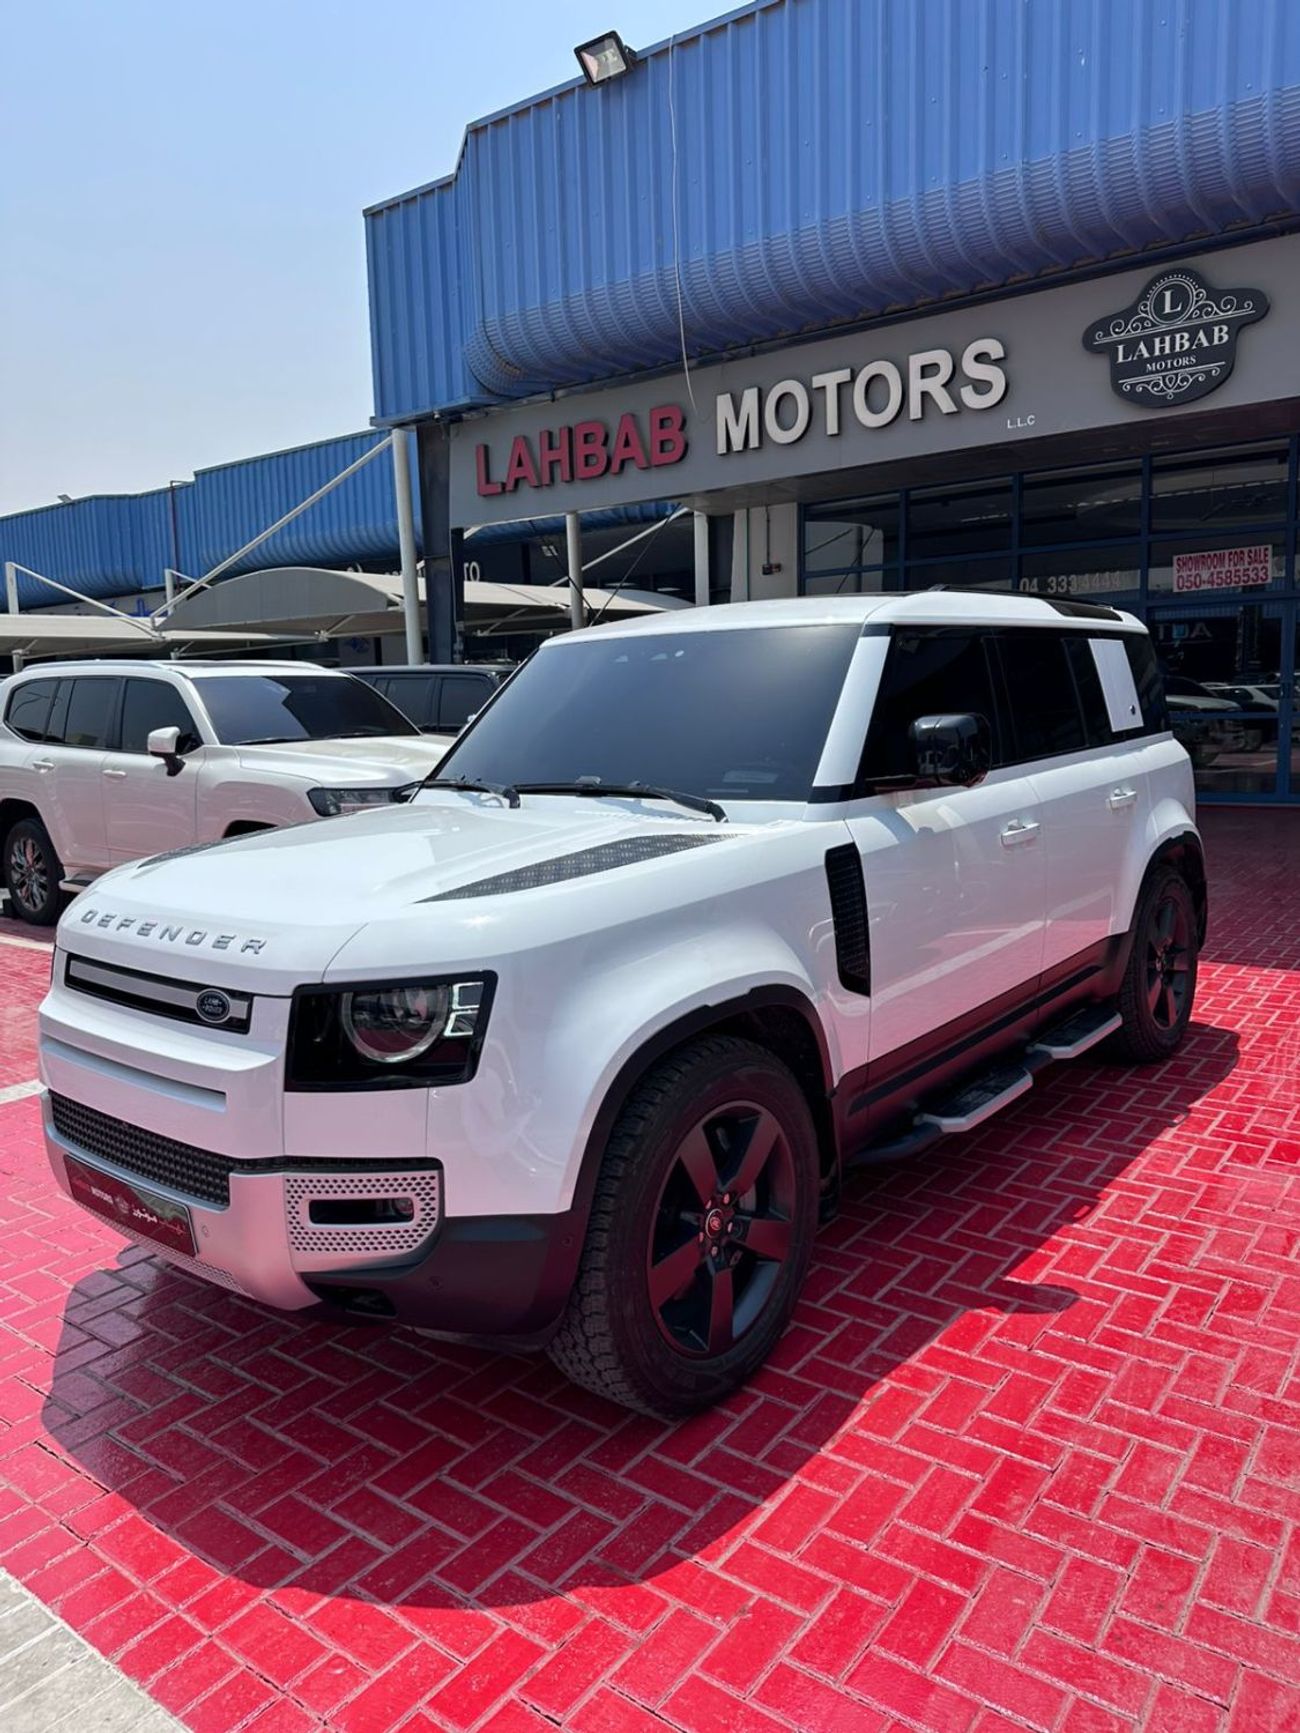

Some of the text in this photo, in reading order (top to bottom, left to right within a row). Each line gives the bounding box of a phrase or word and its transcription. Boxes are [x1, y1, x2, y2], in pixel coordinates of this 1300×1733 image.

[1163, 289, 1182, 314] L
[1116, 324, 1229, 364] LAHBAB
[1146, 355, 1197, 373] MOTORS
[475, 338, 1006, 497] LAHBAB MOTORS
[1007, 414, 1036, 429] L.L.C
[1176, 546, 1269, 574] SHOWROOM FOR SALE
[1176, 565, 1269, 591] 050-4585533
[80, 909, 267, 955] DEFENDER
